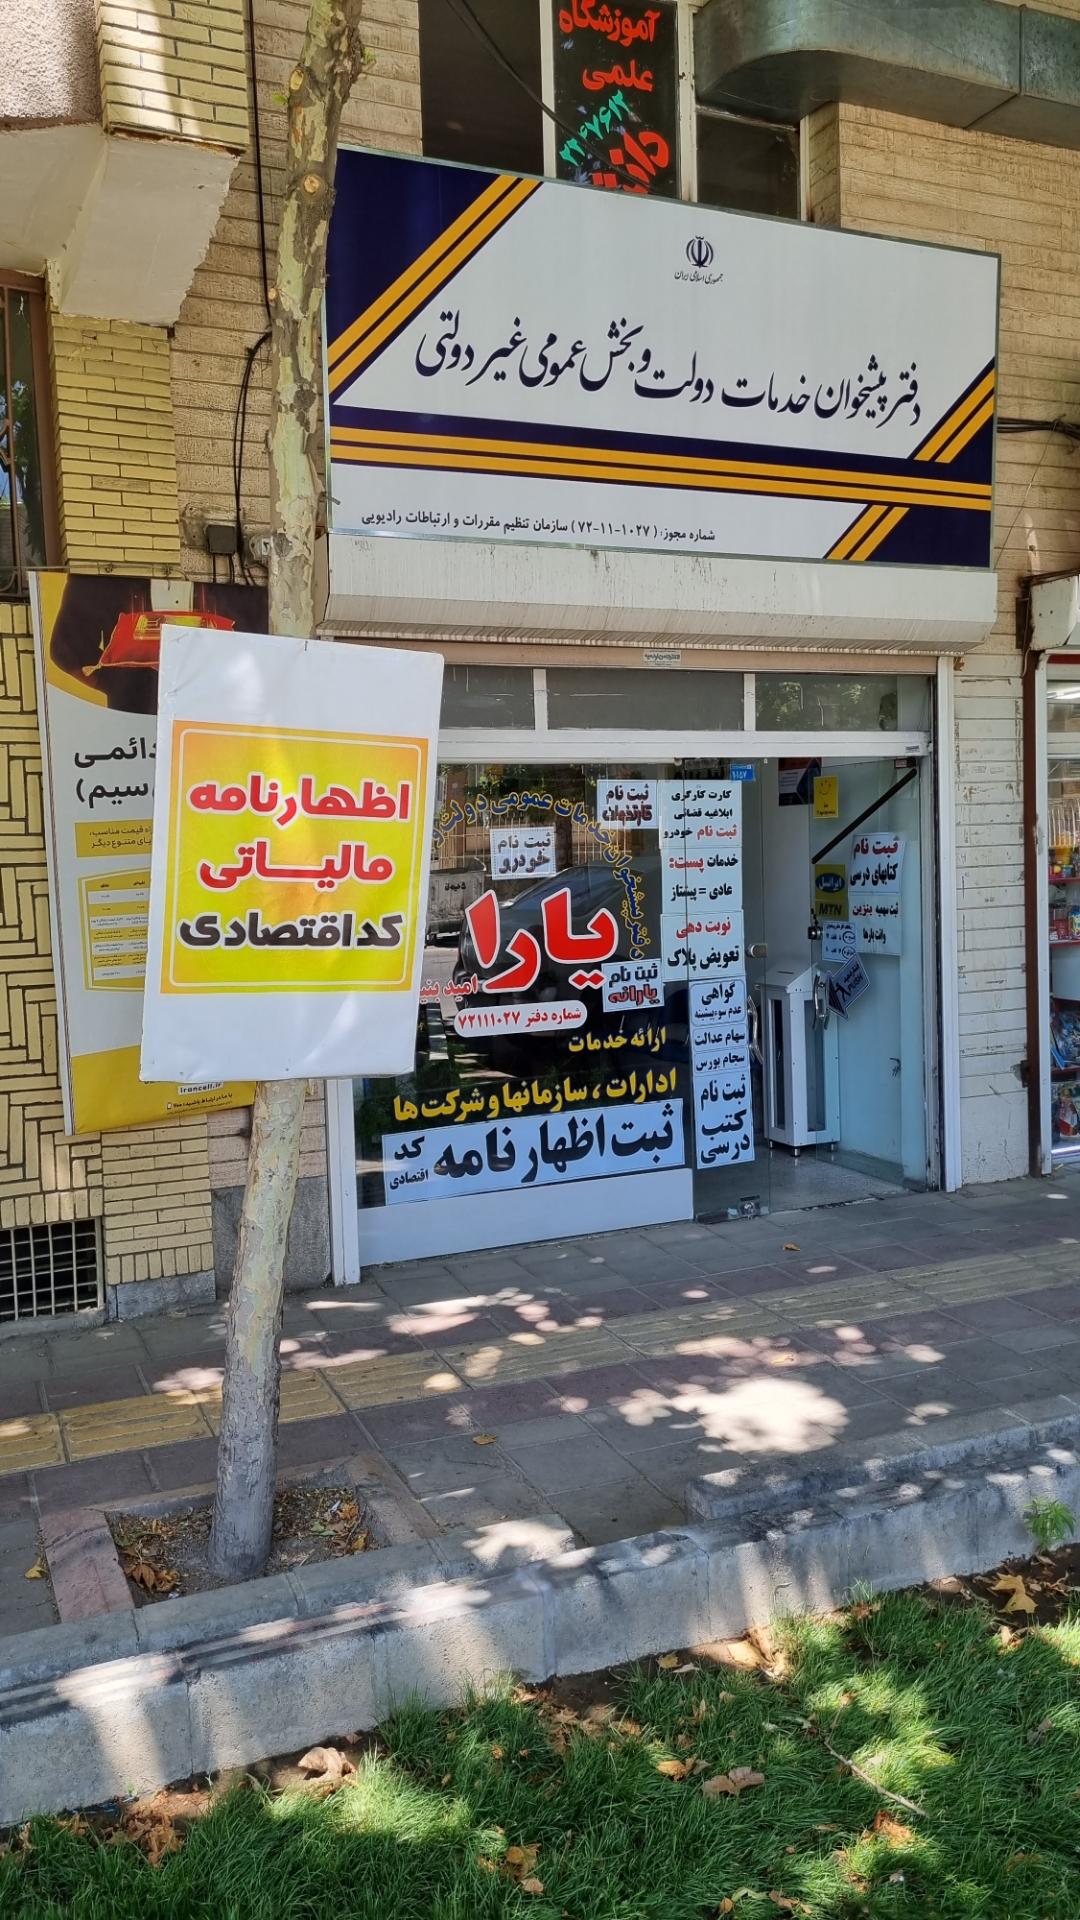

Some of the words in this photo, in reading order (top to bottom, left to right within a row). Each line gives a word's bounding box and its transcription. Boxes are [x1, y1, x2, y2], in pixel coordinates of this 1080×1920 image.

[559, 0, 661, 47] آموزشگاه
[583, 59, 654, 92] علمی
[415, 309, 475, 377] دولتی
[465, 316, 527, 386] غیر
[579, 317, 644, 392] بخش
[519, 332, 587, 388] عمومی
[637, 348, 652, 374] و
[634, 350, 714, 404] دولت
[814, 354, 887, 420] پیشخوان
[721, 371, 811, 414] خدمات
[875, 362, 921, 429] دفتر
[362, 509, 402, 525] رادیویی
[405, 511, 450, 528] ارتباطات
[454, 518, 459, 528] و
[463, 514, 500, 531] مقررات
[503, 516, 529, 535] تنظیم
[533, 517, 568, 534] سازمان
[689, 528, 716, 542] شماره
[190, 775, 410, 826] اظهارنامه
[491, 791, 553, 814] عمومی
[606, 783, 624, 801] نام
[626, 783, 649, 800] ثبت
[671, 789, 706, 802] کارگری
[708, 790, 732, 801] کارت
[440, 794, 488, 832] دولت
[554, 799, 616, 844] خدمات
[704, 808, 733, 819] ابلاغیه
[497, 833, 519, 854] نام
[524, 832, 551, 849] ثبت
[663, 827, 693, 839] خودرو
[696, 825, 713, 840] نام
[716, 824, 737, 840] ثبت
[853, 837, 869, 861] نام
[872, 837, 899, 859] ثبت
[200, 841, 393, 889] مالیاتی
[498, 851, 549, 874] خودرو
[707, 853, 739, 868] خدمات
[818, 876, 843, 892] ایرانسل
[850, 866, 870, 887] درسی
[872, 862, 899, 886] کتابهای
[670, 883, 697, 901] پیشتاز
[709, 883, 733, 900] عادی
[819, 903, 842, 915] MTN
[852, 903, 872, 917] بنزین
[676, 921, 702, 939] دهی
[705, 917, 731, 935] نوبت
[465, 888, 619, 993] یارا
[625, 918, 651, 960] دفتر
[667, 948, 697, 971] پلاک
[700, 945, 740, 970] تعویض
[608, 968, 631, 988] نام
[634, 963, 659, 982] ثبت
[419, 979, 442, 1005] بنی
[443, 973, 479, 1002] امید
[608, 985, 658, 1006] یارانه
[701, 982, 736, 1005] گواهی
[458, 1010, 522, 1030] ۷۲۱۱۱۰۲۷
[525, 1009, 547, 1027] دفتر
[551, 1008, 582, 1026] شماره
[728, 1006, 742, 1018] عدم
[568, 1030, 628, 1053] خدمات
[630, 1026, 667, 1053] ارائه
[695, 1031, 723, 1046] عدالت
[725, 1029, 745, 1044] سهام
[696, 1056, 721, 1071] بورس
[723, 1052, 745, 1068] سجام
[502, 1077, 587, 1113] سازمانها
[606, 1066, 677, 1104] ادارات
[700, 1080, 719, 1111] نام
[722, 1074, 746, 1105] ثبت
[393, 1096, 419, 1121] ها
[421, 1088, 484, 1122] شرکت
[487, 1096, 499, 1119] و
[611, 1102, 675, 1164] ثبت
[701, 1109, 747, 1141] کتب
[394, 1136, 425, 1161] کد
[701, 1133, 751, 1164] درسی
[390, 1168, 429, 1191] اقتصادی
